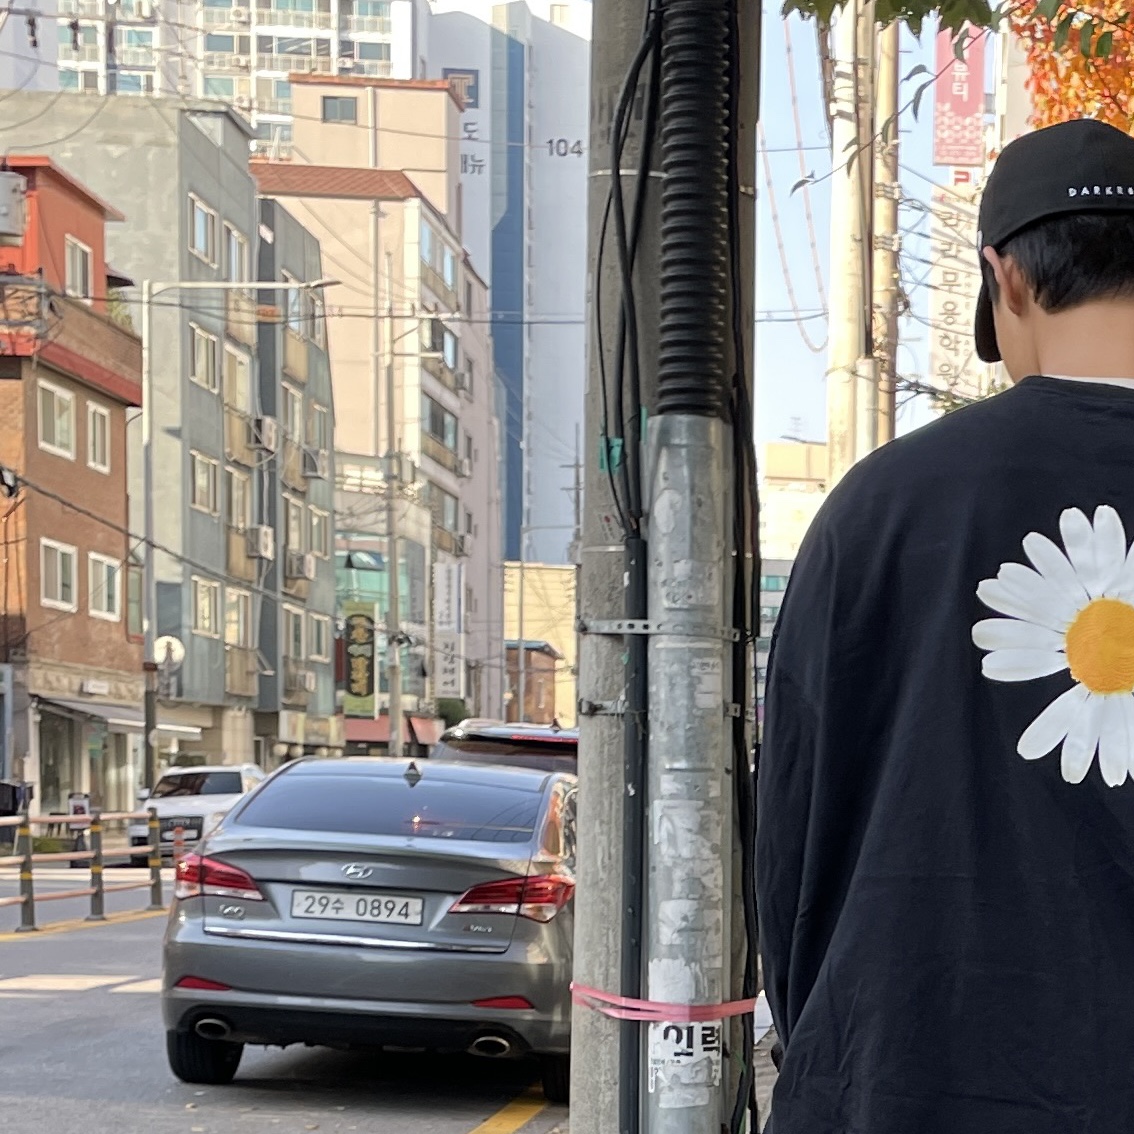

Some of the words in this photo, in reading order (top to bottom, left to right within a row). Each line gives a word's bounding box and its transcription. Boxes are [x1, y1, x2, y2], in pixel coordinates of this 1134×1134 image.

[546, 138, 584, 158] 104
[303, 894, 345, 915] 29수
[355, 898, 410, 920] 0894
